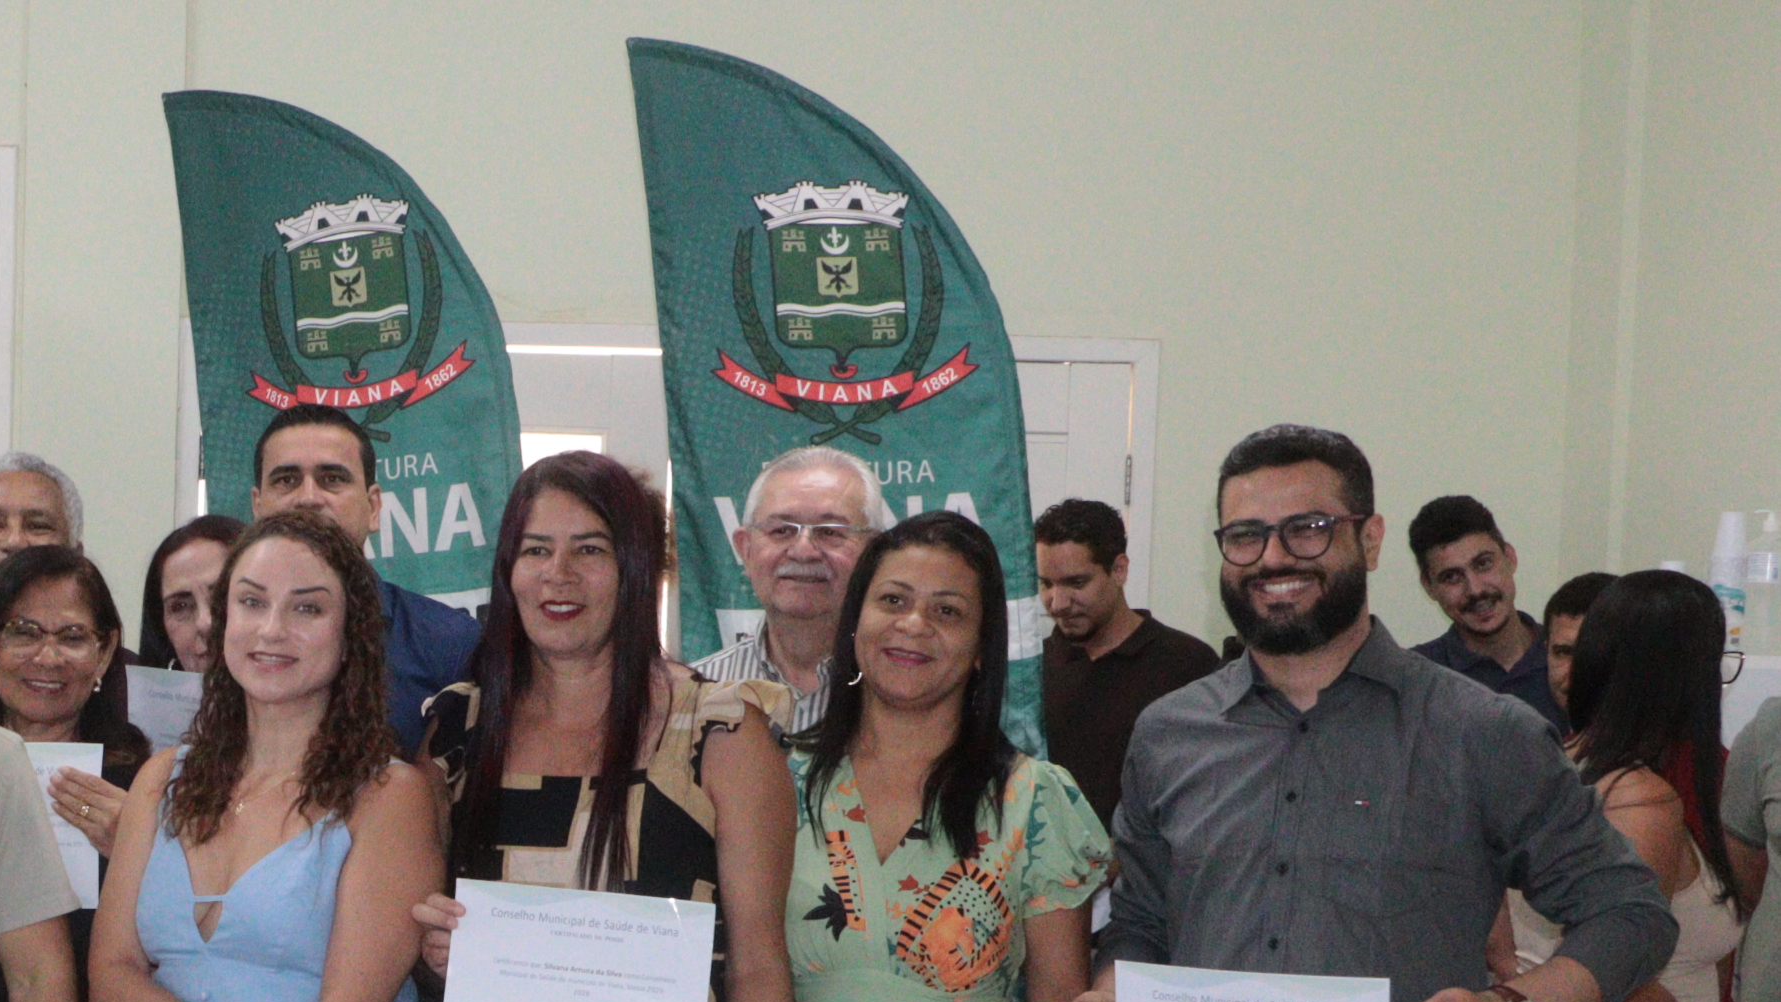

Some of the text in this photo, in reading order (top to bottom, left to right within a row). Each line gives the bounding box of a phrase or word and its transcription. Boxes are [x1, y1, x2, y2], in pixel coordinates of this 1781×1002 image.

[265, 364, 458, 408] 1813 VIANA 1862
[733, 367, 958, 403] 1813 VIANA 1862
[490, 907, 679, 937] Conselho Municipal de Saúde de Viana
[1152, 989, 1196, 1002] Conselho
